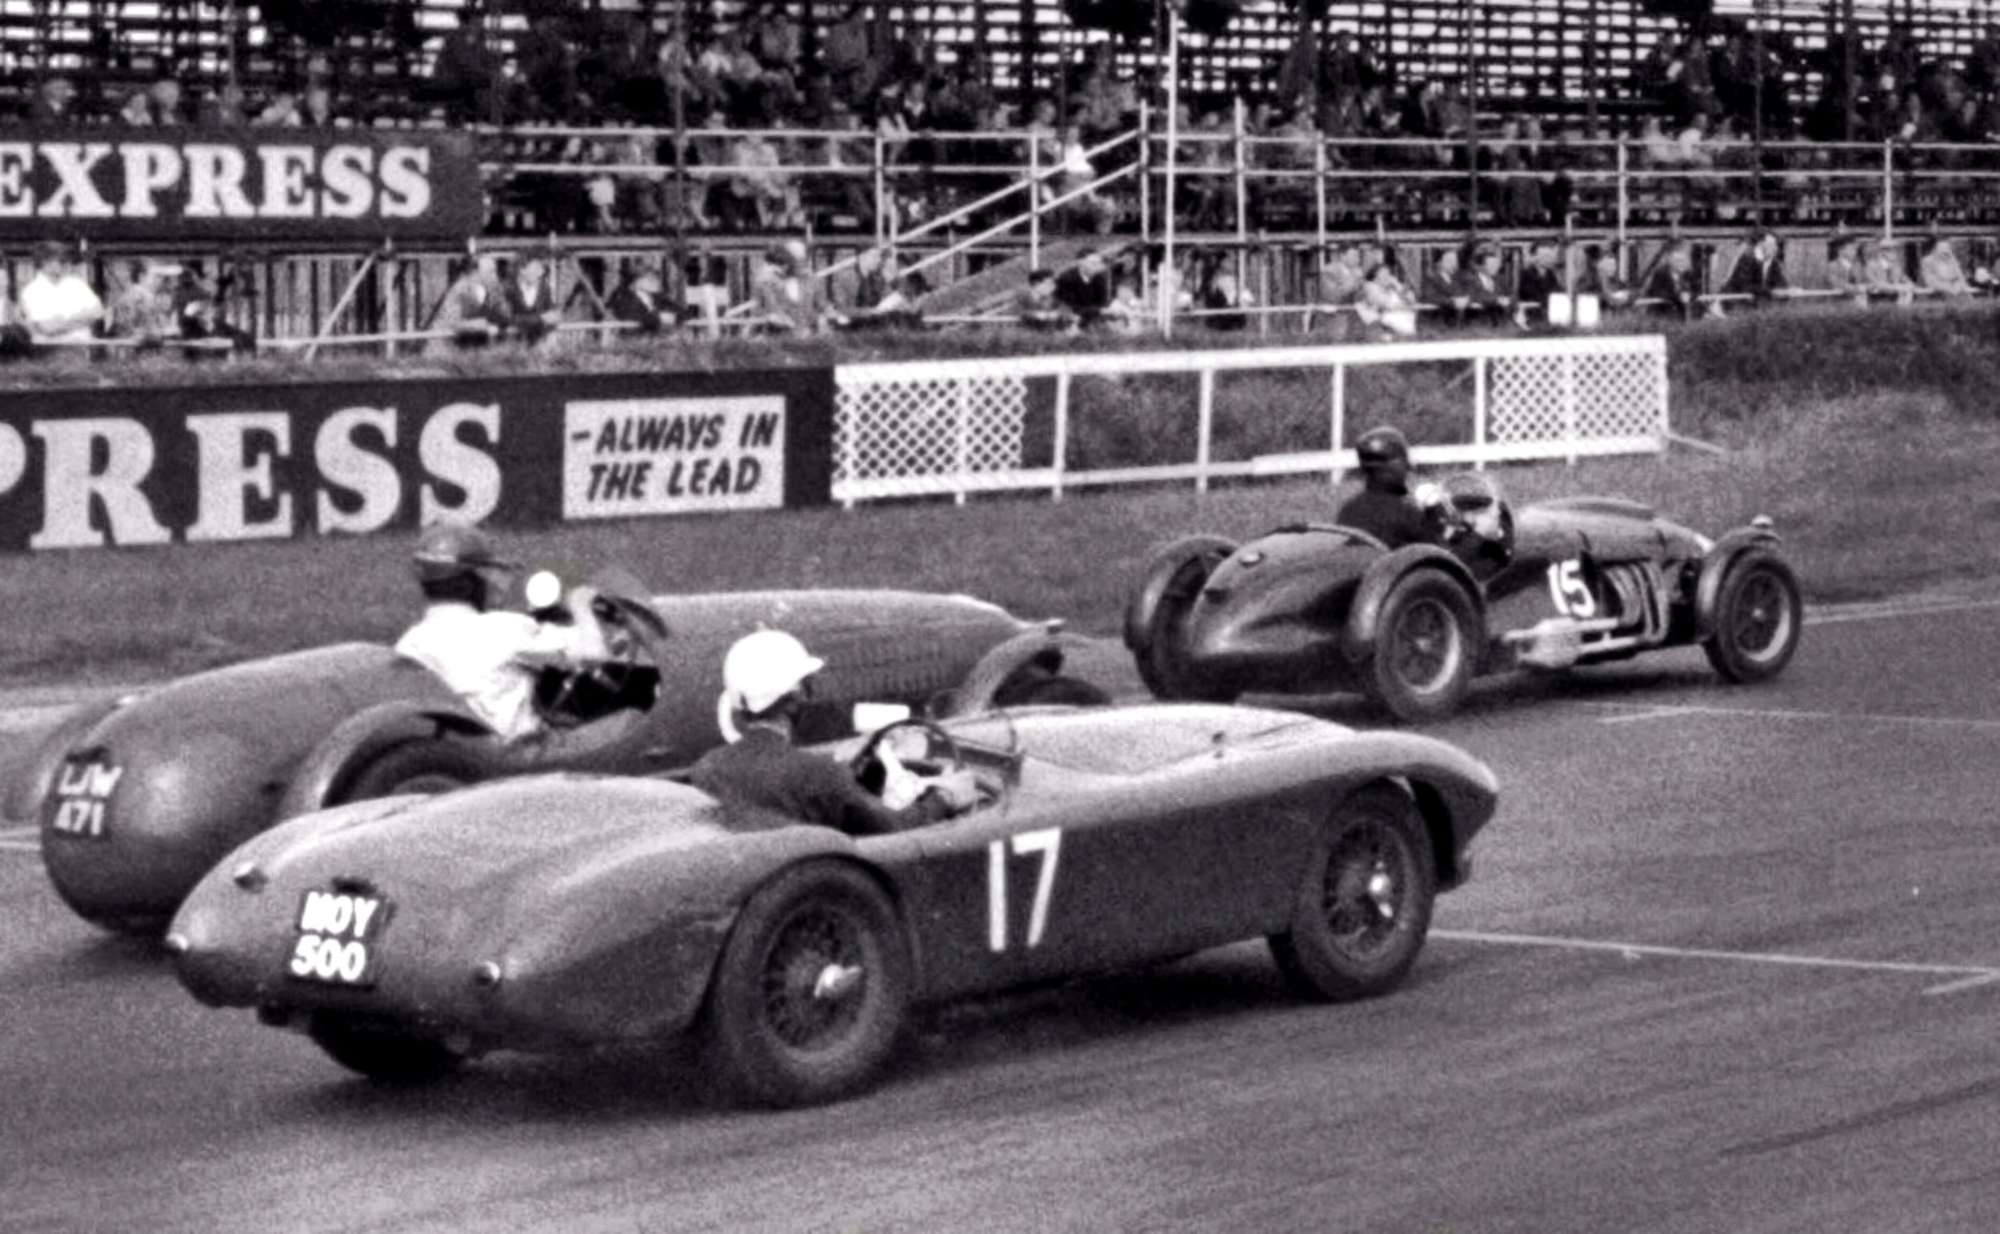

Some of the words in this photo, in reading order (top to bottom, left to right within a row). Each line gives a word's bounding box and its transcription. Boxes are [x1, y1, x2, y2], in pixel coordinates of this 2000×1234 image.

[0, 142, 431, 218] EXPRESS
[739, 412, 779, 447] IN
[0, 402, 502, 549] RESS
[587, 461, 653, 501] THE
[667, 456, 762, 497] LEAD
[1547, 559, 1596, 618] 15
[989, 826, 1062, 952] 17
[290, 934, 366, 982] 500
